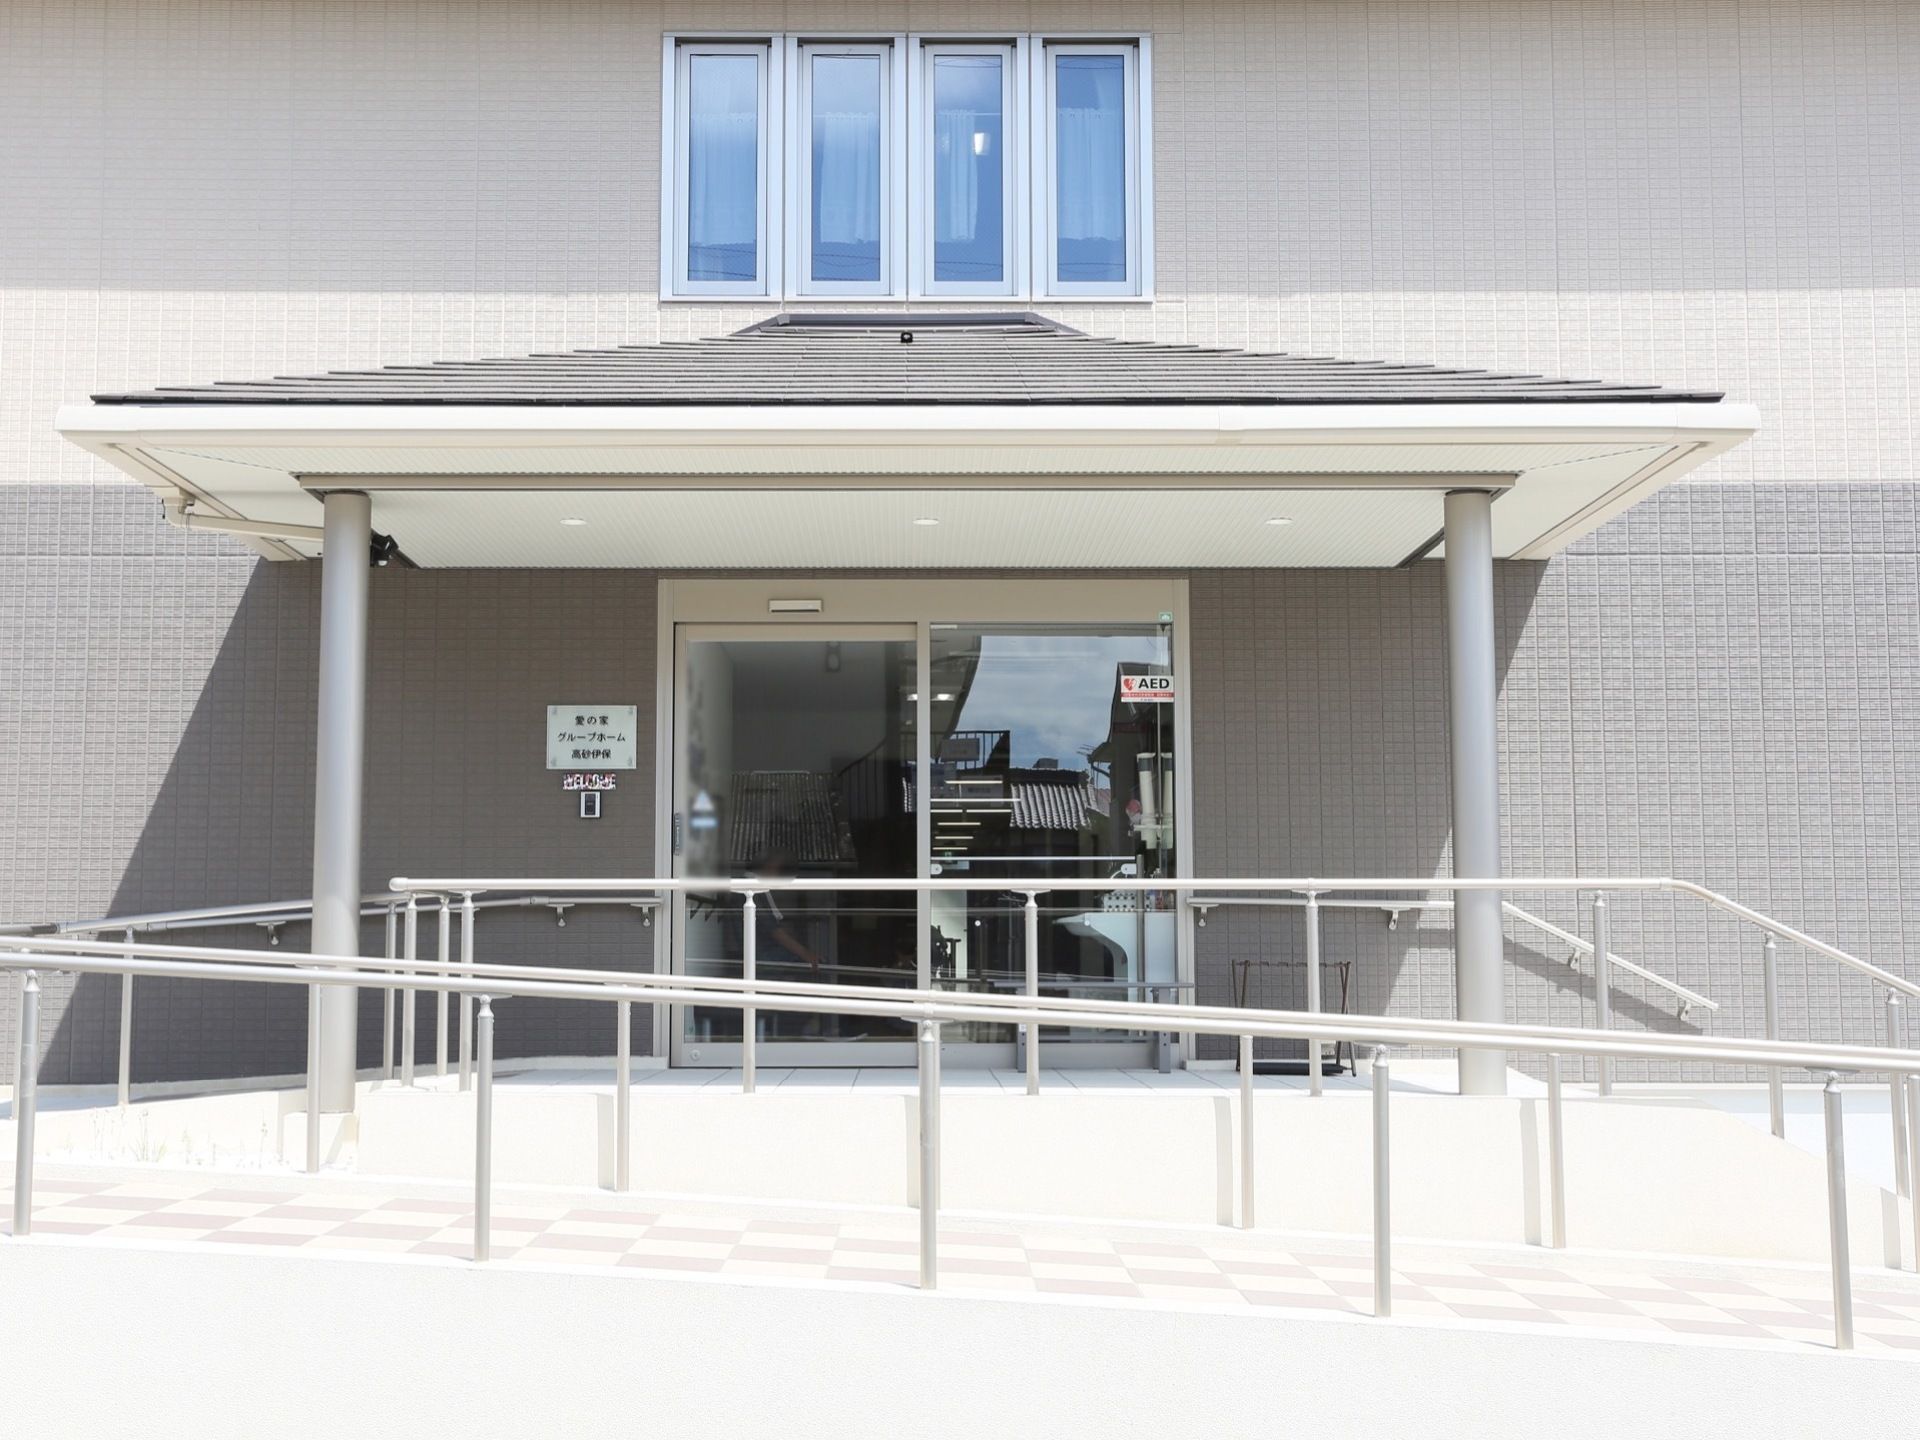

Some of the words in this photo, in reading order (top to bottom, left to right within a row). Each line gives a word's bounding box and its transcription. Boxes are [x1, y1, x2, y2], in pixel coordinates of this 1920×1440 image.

[1138, 678, 1170, 689] AED
[575, 715, 609, 726] 愛の家
[557, 731, 626, 742] グループホーム
[571, 749, 612, 760] 高砂伊保
